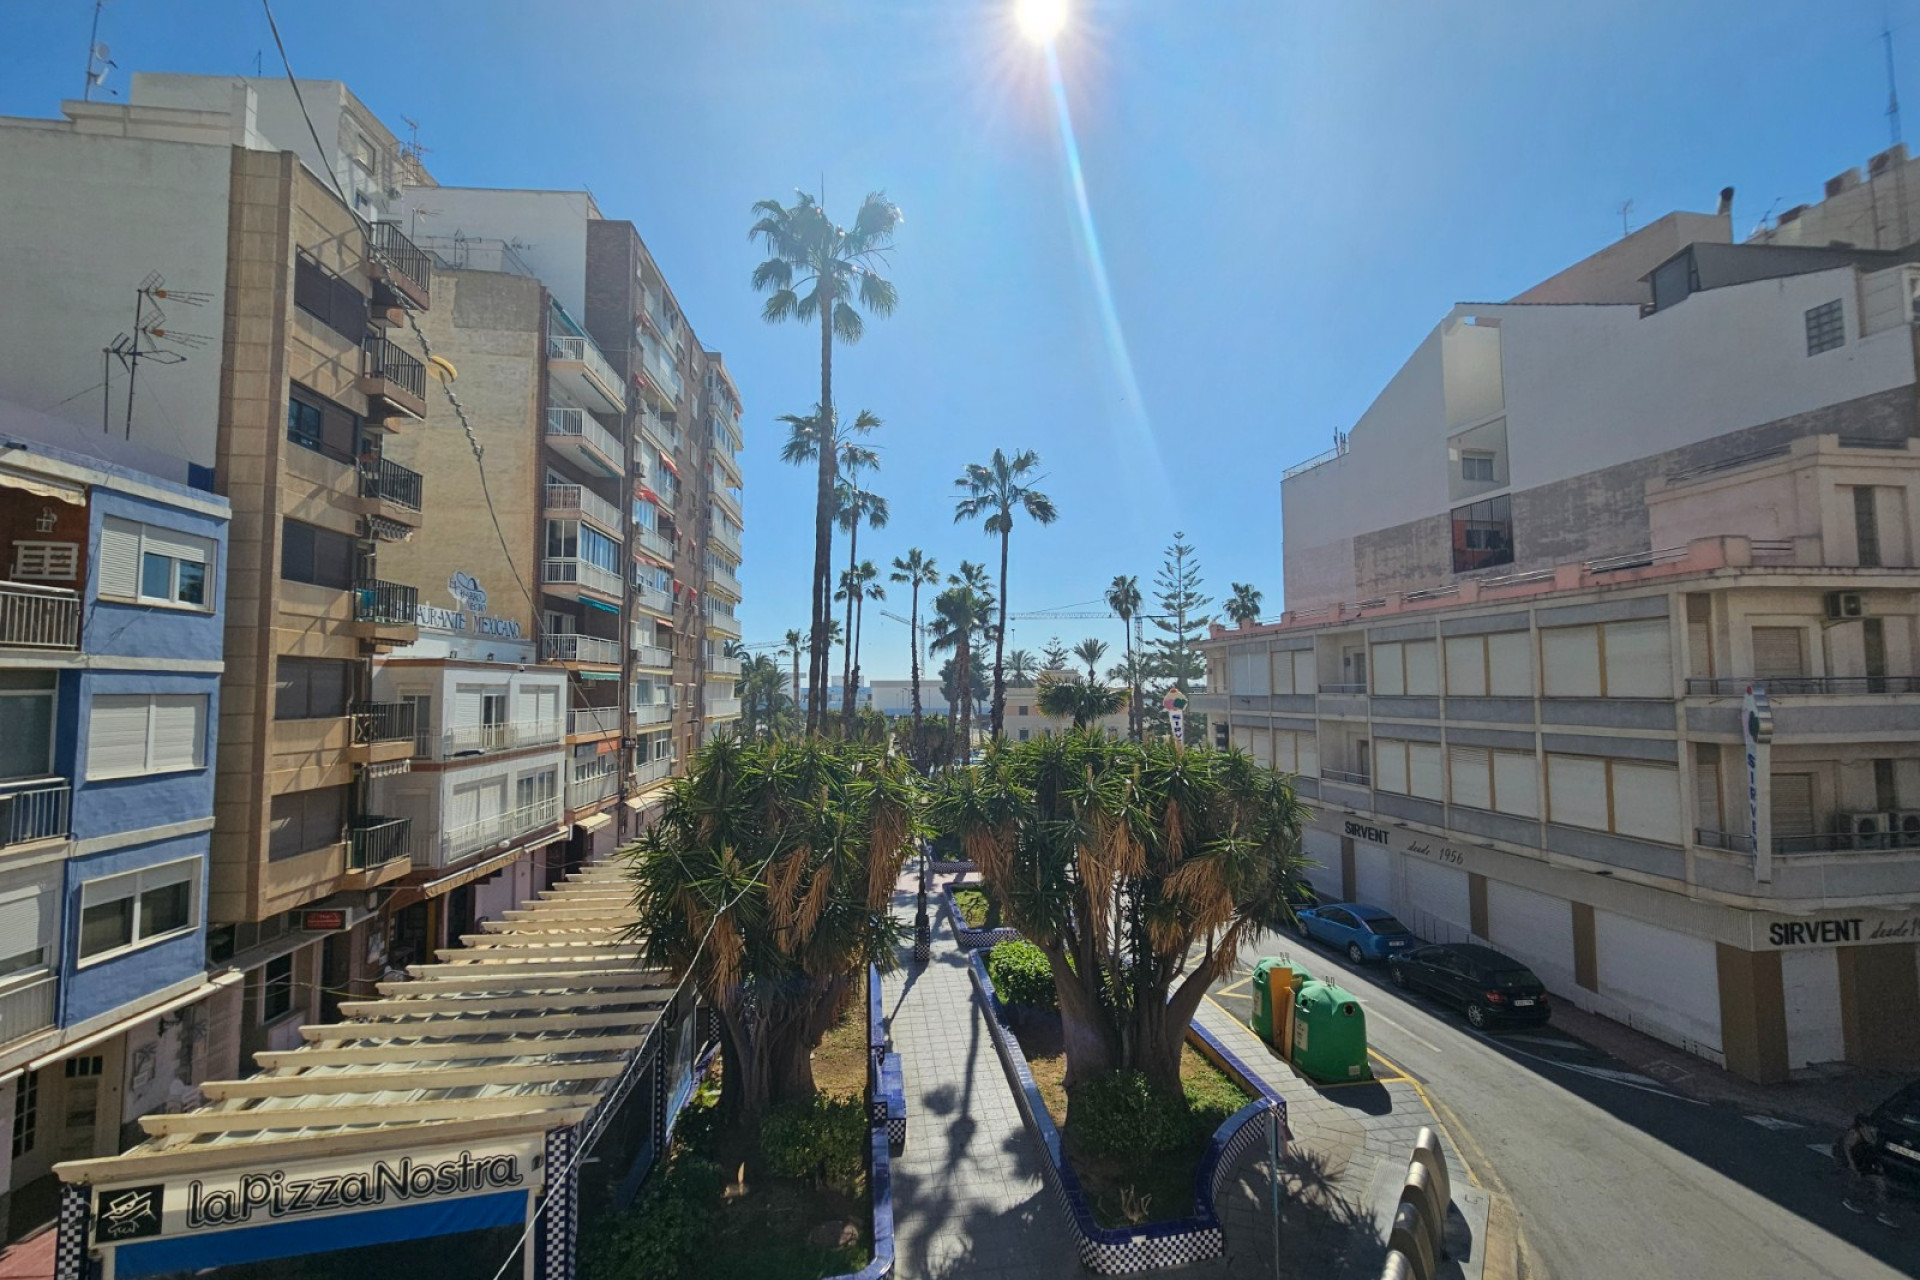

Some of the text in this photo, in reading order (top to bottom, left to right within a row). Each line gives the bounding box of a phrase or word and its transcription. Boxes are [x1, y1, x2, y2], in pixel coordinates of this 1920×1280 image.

[1345, 821, 1389, 845] SIRVENT
[1439, 848, 1464, 865] 1956
[1769, 919, 1863, 945] SIRVENT
